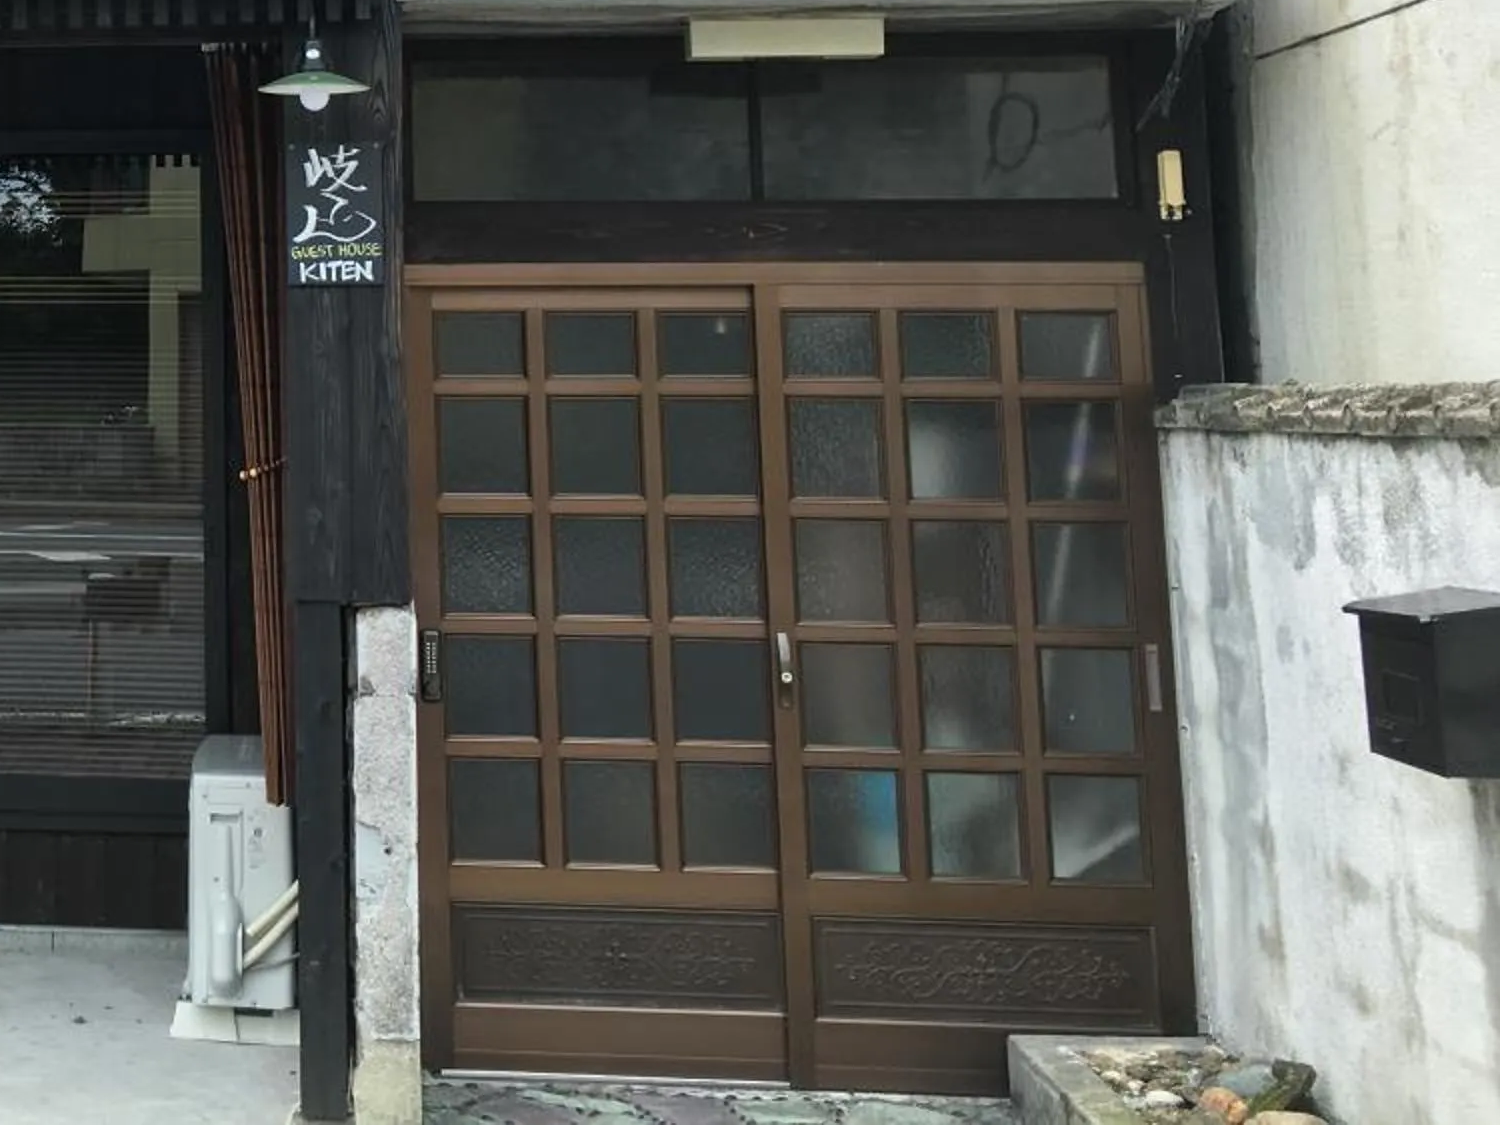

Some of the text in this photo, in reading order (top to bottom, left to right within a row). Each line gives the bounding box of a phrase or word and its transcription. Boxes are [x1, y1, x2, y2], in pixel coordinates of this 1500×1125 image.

[291, 242, 383, 260] GUEST HOUSE
[299, 260, 375, 284] KITEN
